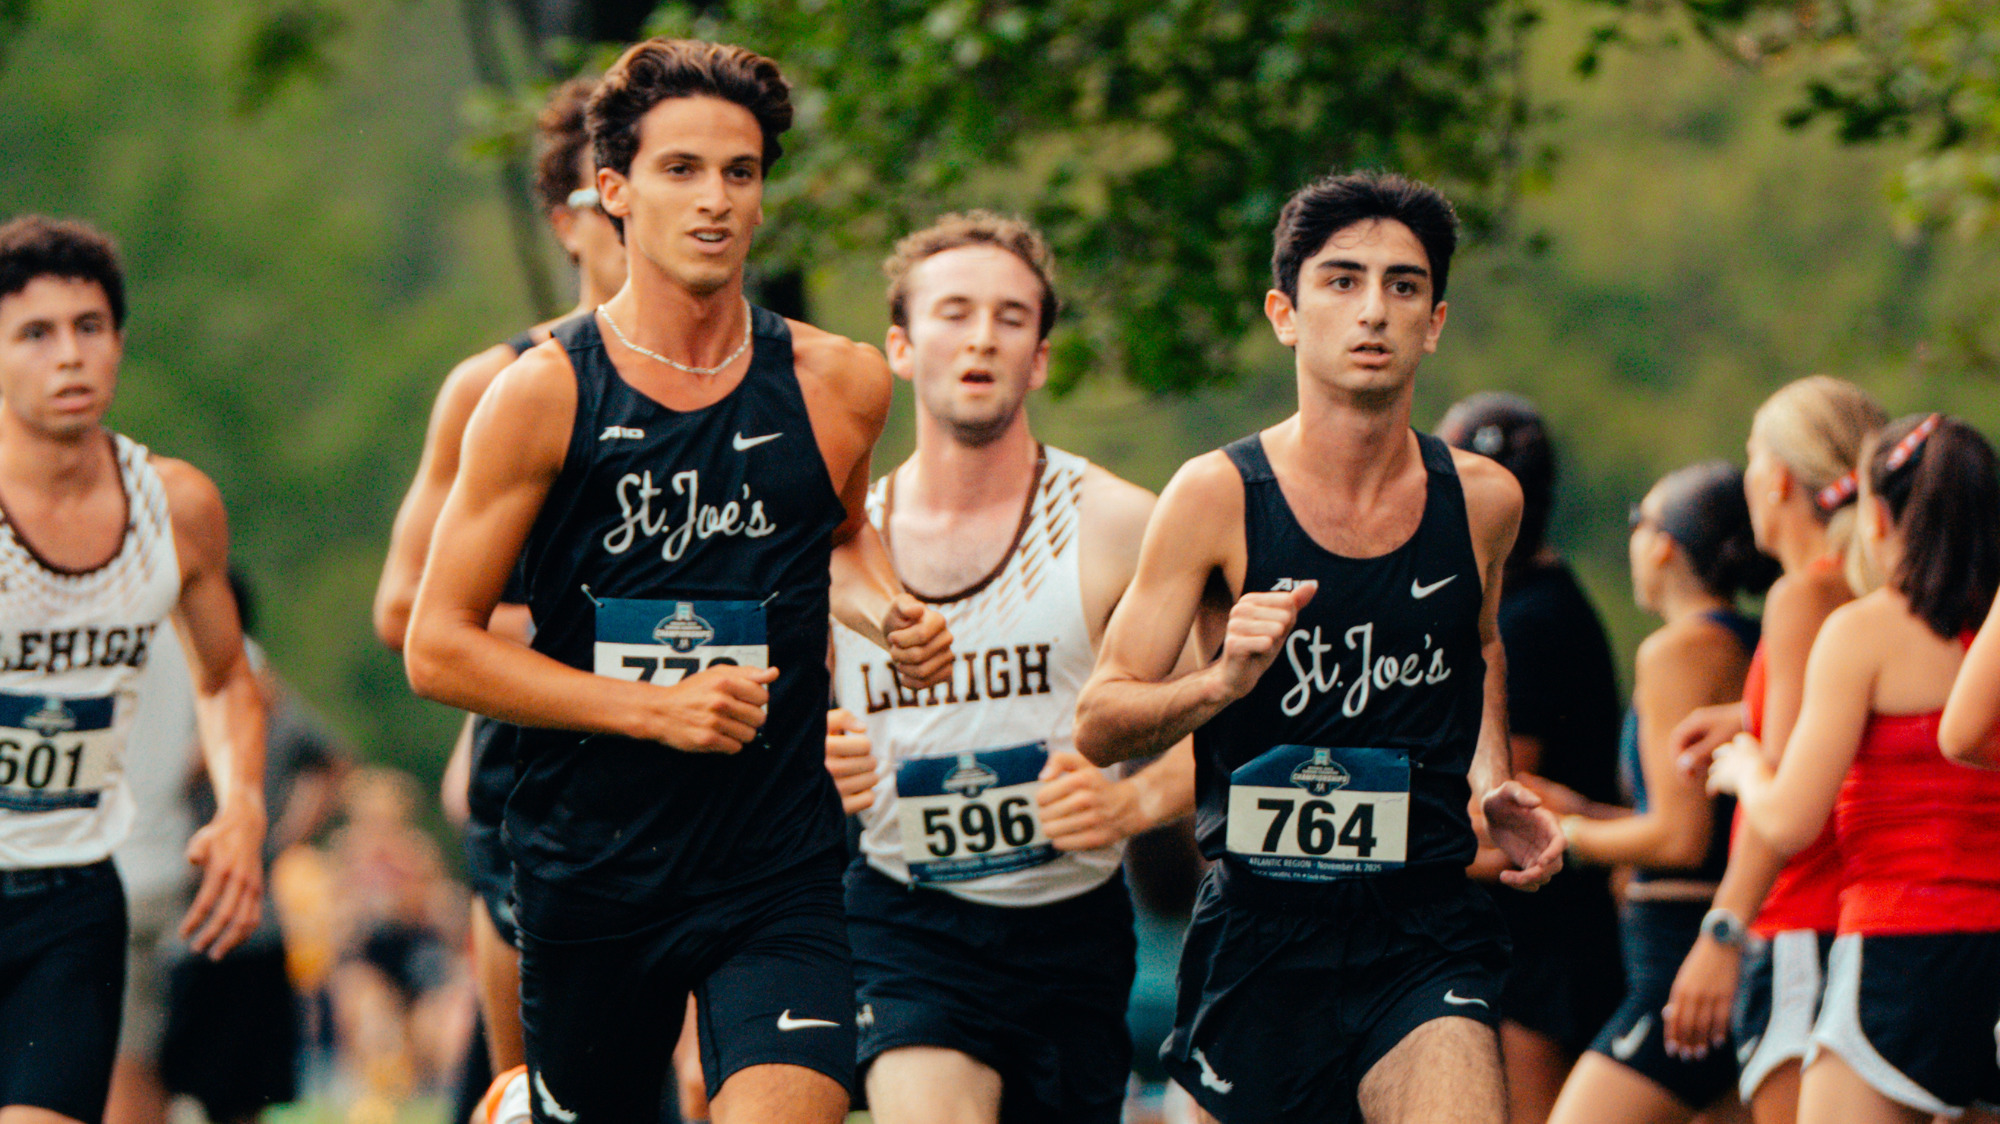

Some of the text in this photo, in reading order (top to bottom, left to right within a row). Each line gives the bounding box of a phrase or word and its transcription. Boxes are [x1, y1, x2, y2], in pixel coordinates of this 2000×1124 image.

[621, 656, 739, 683] 77
[0, 740, 84, 788] 601
[922, 796, 1035, 857] 596
[1257, 798, 1377, 857] 764
[1249, 857, 1282, 868] ATLANTIC
[1283, 859, 1312, 869] REGION
[1316, 860, 1354, 872] November
